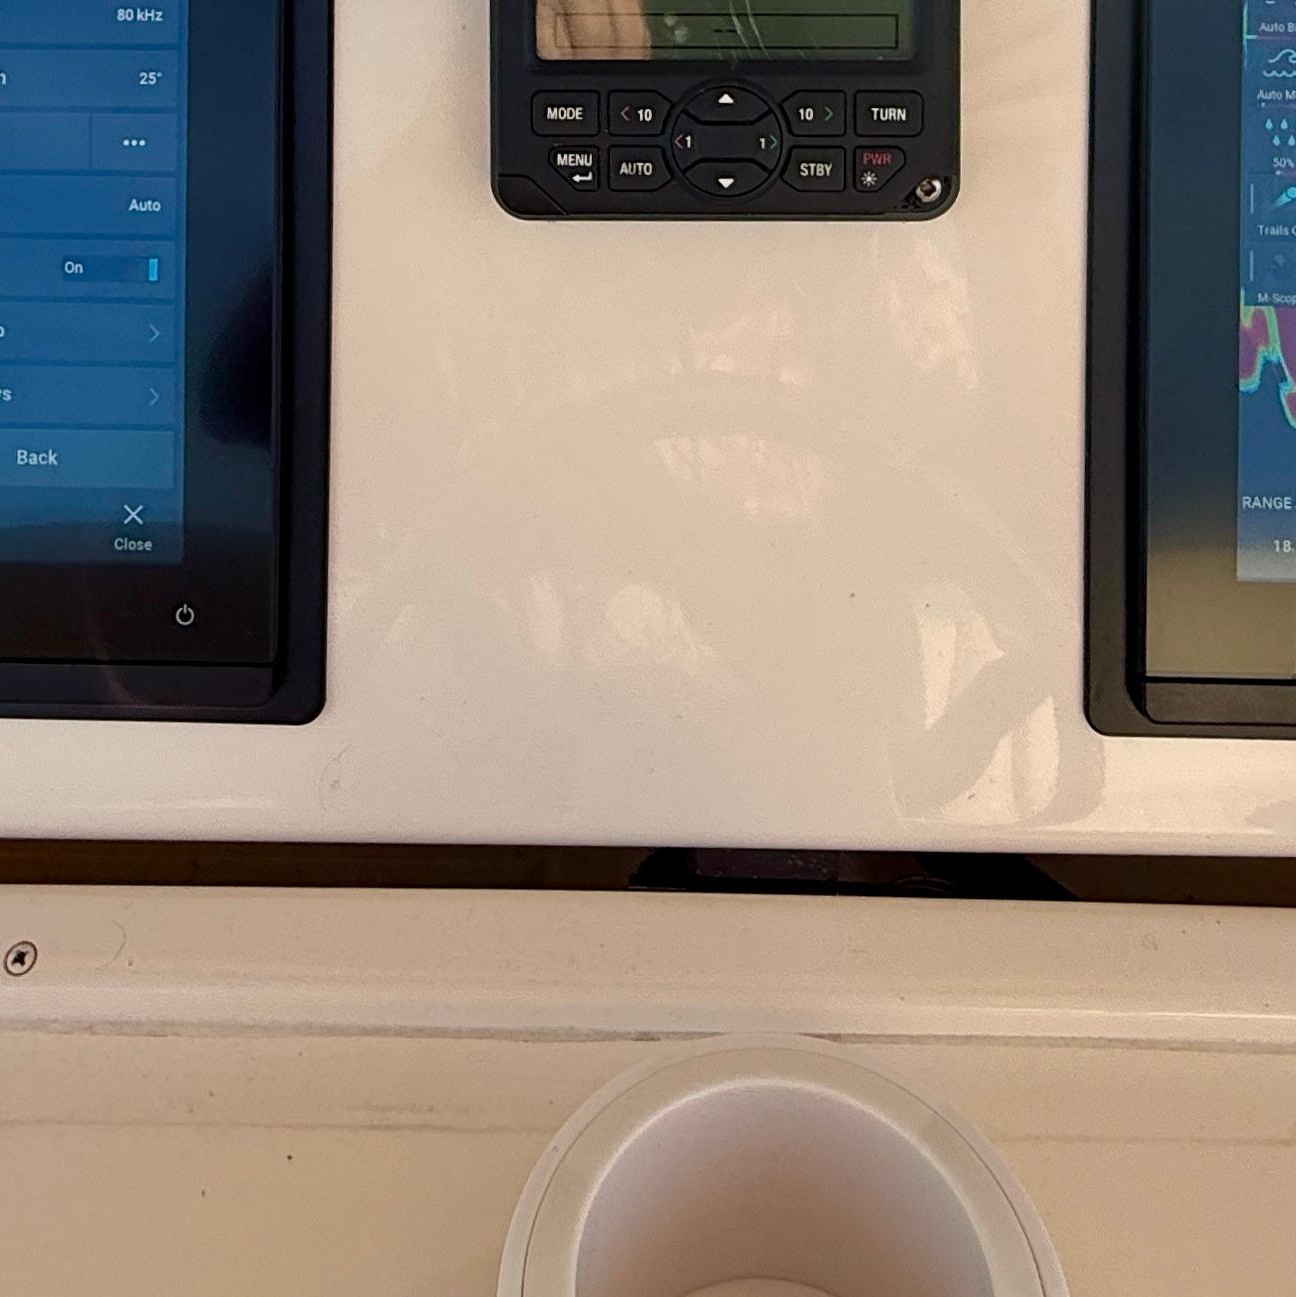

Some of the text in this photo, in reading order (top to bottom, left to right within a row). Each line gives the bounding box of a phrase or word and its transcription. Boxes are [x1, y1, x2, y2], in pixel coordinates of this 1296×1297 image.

[116, 7, 164, 22] 80 kHz
[1259, 21, 1285, 33] Auto
[1257, 89, 1283, 101] Auto
[546, 107, 584, 121] MODE
[637, 108, 653, 122] 10
[798, 107, 814, 121] 10
[871, 107, 907, 121] TURN
[556, 154, 593, 168] MENU
[862, 152, 892, 166] PWR
[1273, 157, 1295, 168] 50%
[619, 162, 653, 177] AUTO
[799, 163, 832, 177] STBY
[129, 198, 162, 213] Auto
[1258, 225, 1290, 236] Trails
[64, 260, 84, 275] On
[16, 449, 58, 466] Back
[1242, 496, 1292, 509] RANGE
[114, 537, 153, 552] Close
